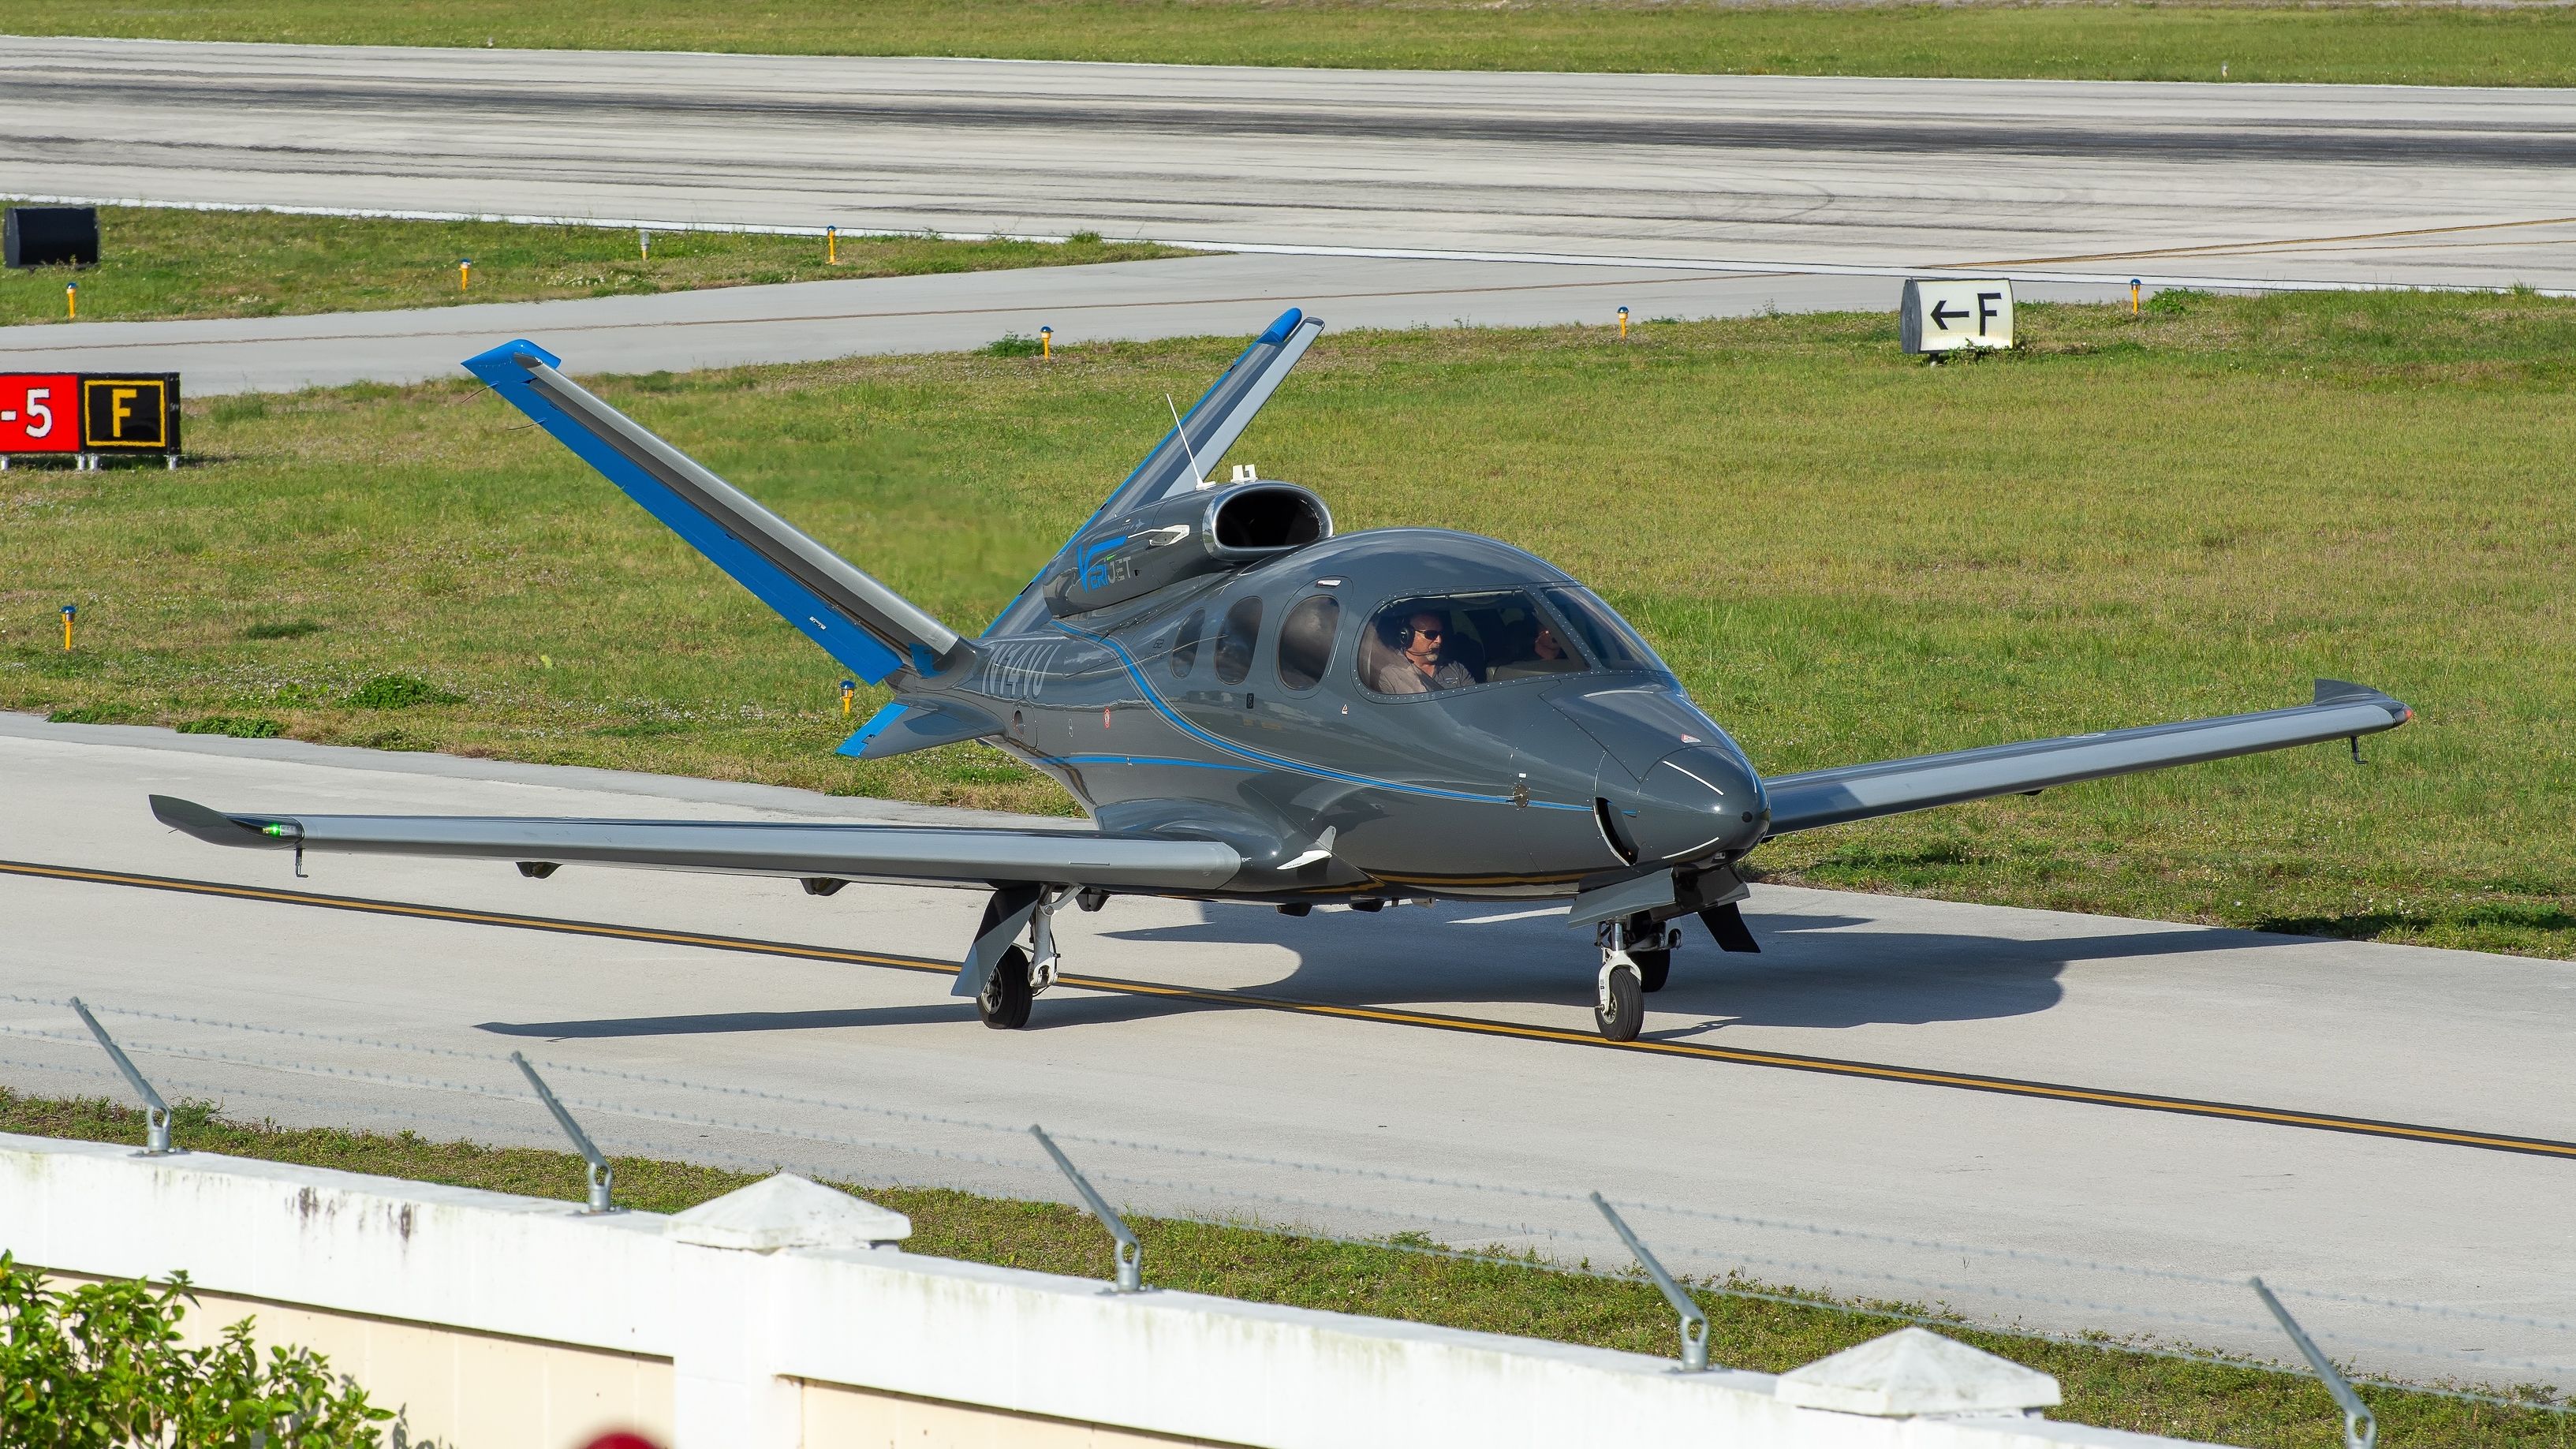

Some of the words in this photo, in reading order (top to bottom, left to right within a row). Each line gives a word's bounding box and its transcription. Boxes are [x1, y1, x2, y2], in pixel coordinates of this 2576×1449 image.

[1977, 292, 2002, 336] F
[112, 388, 137, 438] F
[981, 643, 1062, 696] N14VJ
